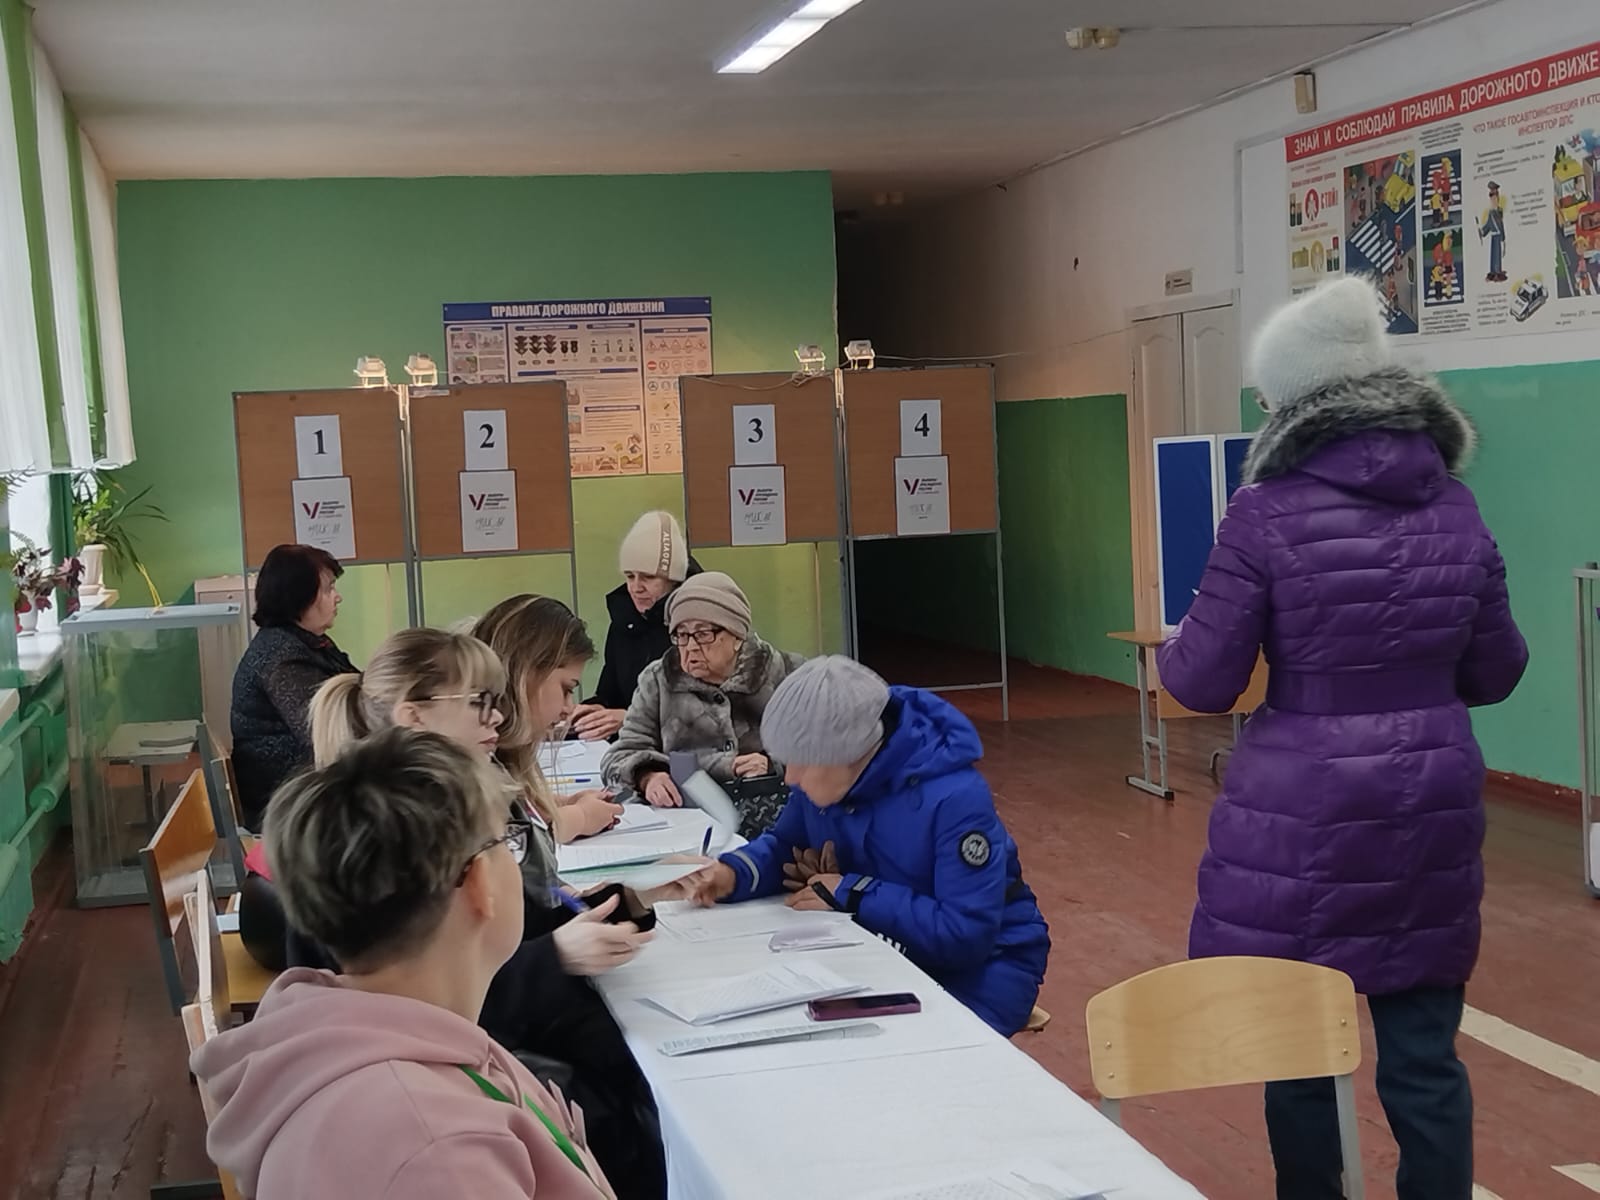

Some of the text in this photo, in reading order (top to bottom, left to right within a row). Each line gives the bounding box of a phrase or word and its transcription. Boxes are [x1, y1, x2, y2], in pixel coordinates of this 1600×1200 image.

[1294, 128, 1319, 155] ЗНАЙ
[1323, 127, 1332, 147] И
[1335, 106, 1397, 142] СОБЛЮДАЙ
[1401, 93, 1454, 125] ПРАВИЛА
[1459, 67, 1542, 111] ДОРОЖНОГО
[1547, 50, 1600, 88] ДВИЖЕ
[491, 301, 665, 318] ПРАВИЛА ДОРОЖНОГО ДВИЖЕНИЯ
[479, 423, 495, 449] 2
[748, 417, 763, 443] 3
[914, 412, 930, 437] 4
[313, 429, 327, 455] 1
